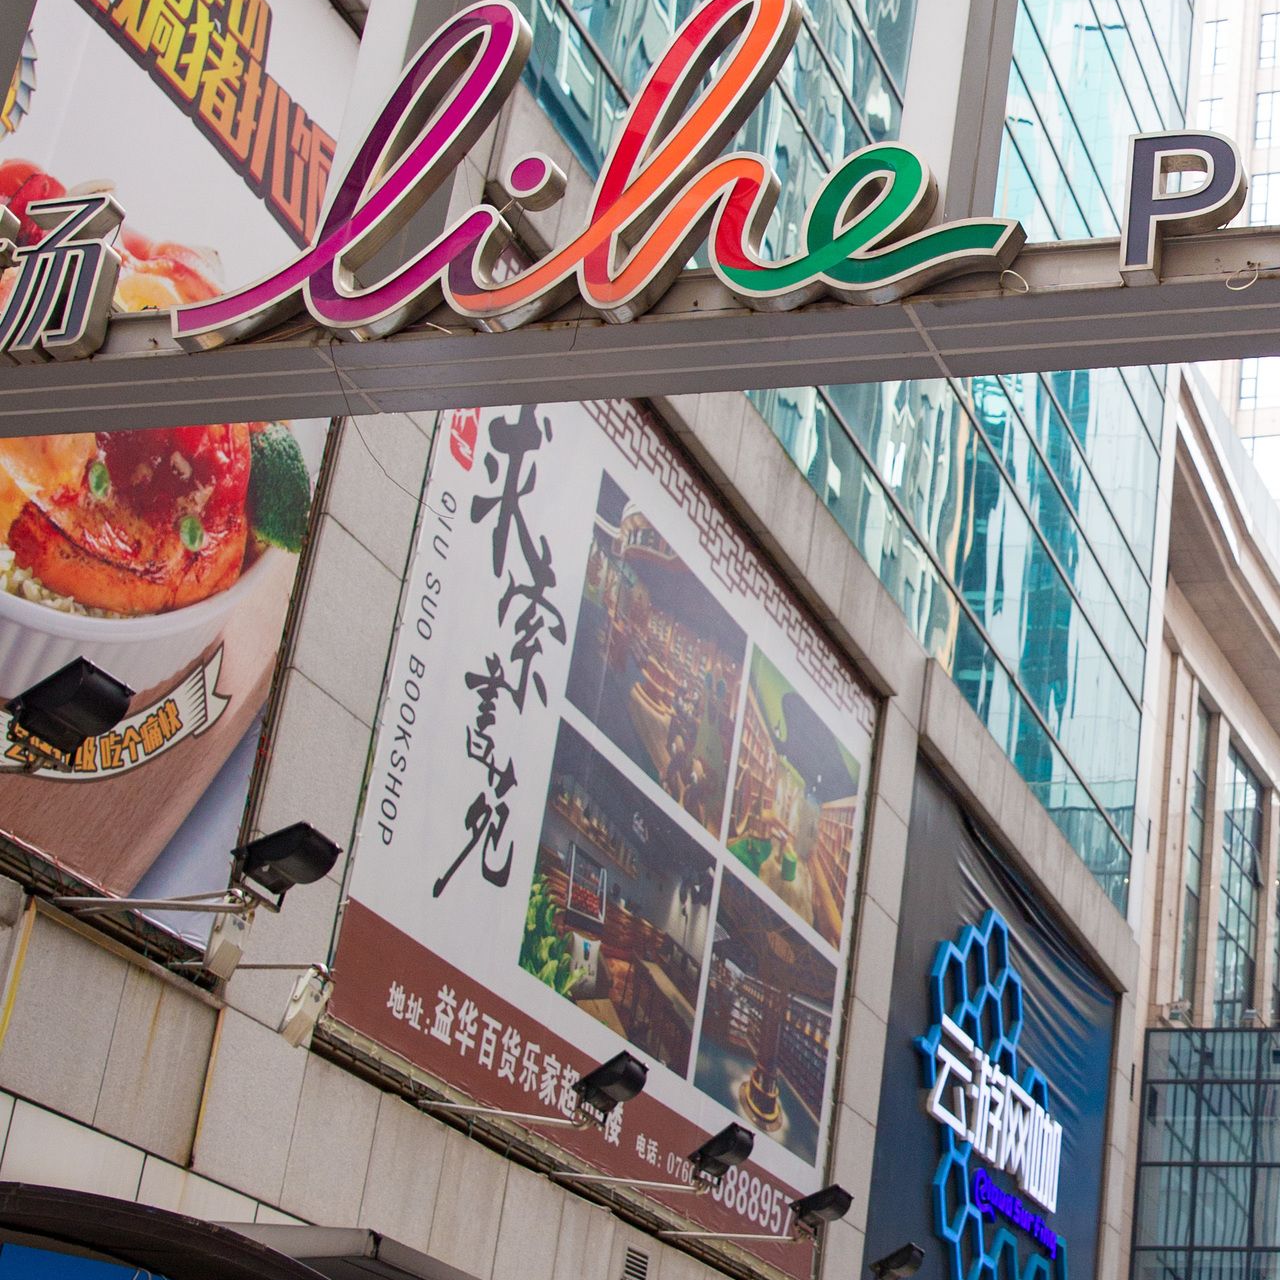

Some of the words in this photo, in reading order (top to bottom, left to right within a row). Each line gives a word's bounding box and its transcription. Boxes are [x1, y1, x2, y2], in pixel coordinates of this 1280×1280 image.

[416, 574, 442, 641] SUO
[433, 490, 458, 562] QIU
[380, 660, 426, 847] BOOKSHOP
[430, 983, 625, 1148] 益华百货乐家超楼
[926, 1012, 1064, 1215] 云游网咖
